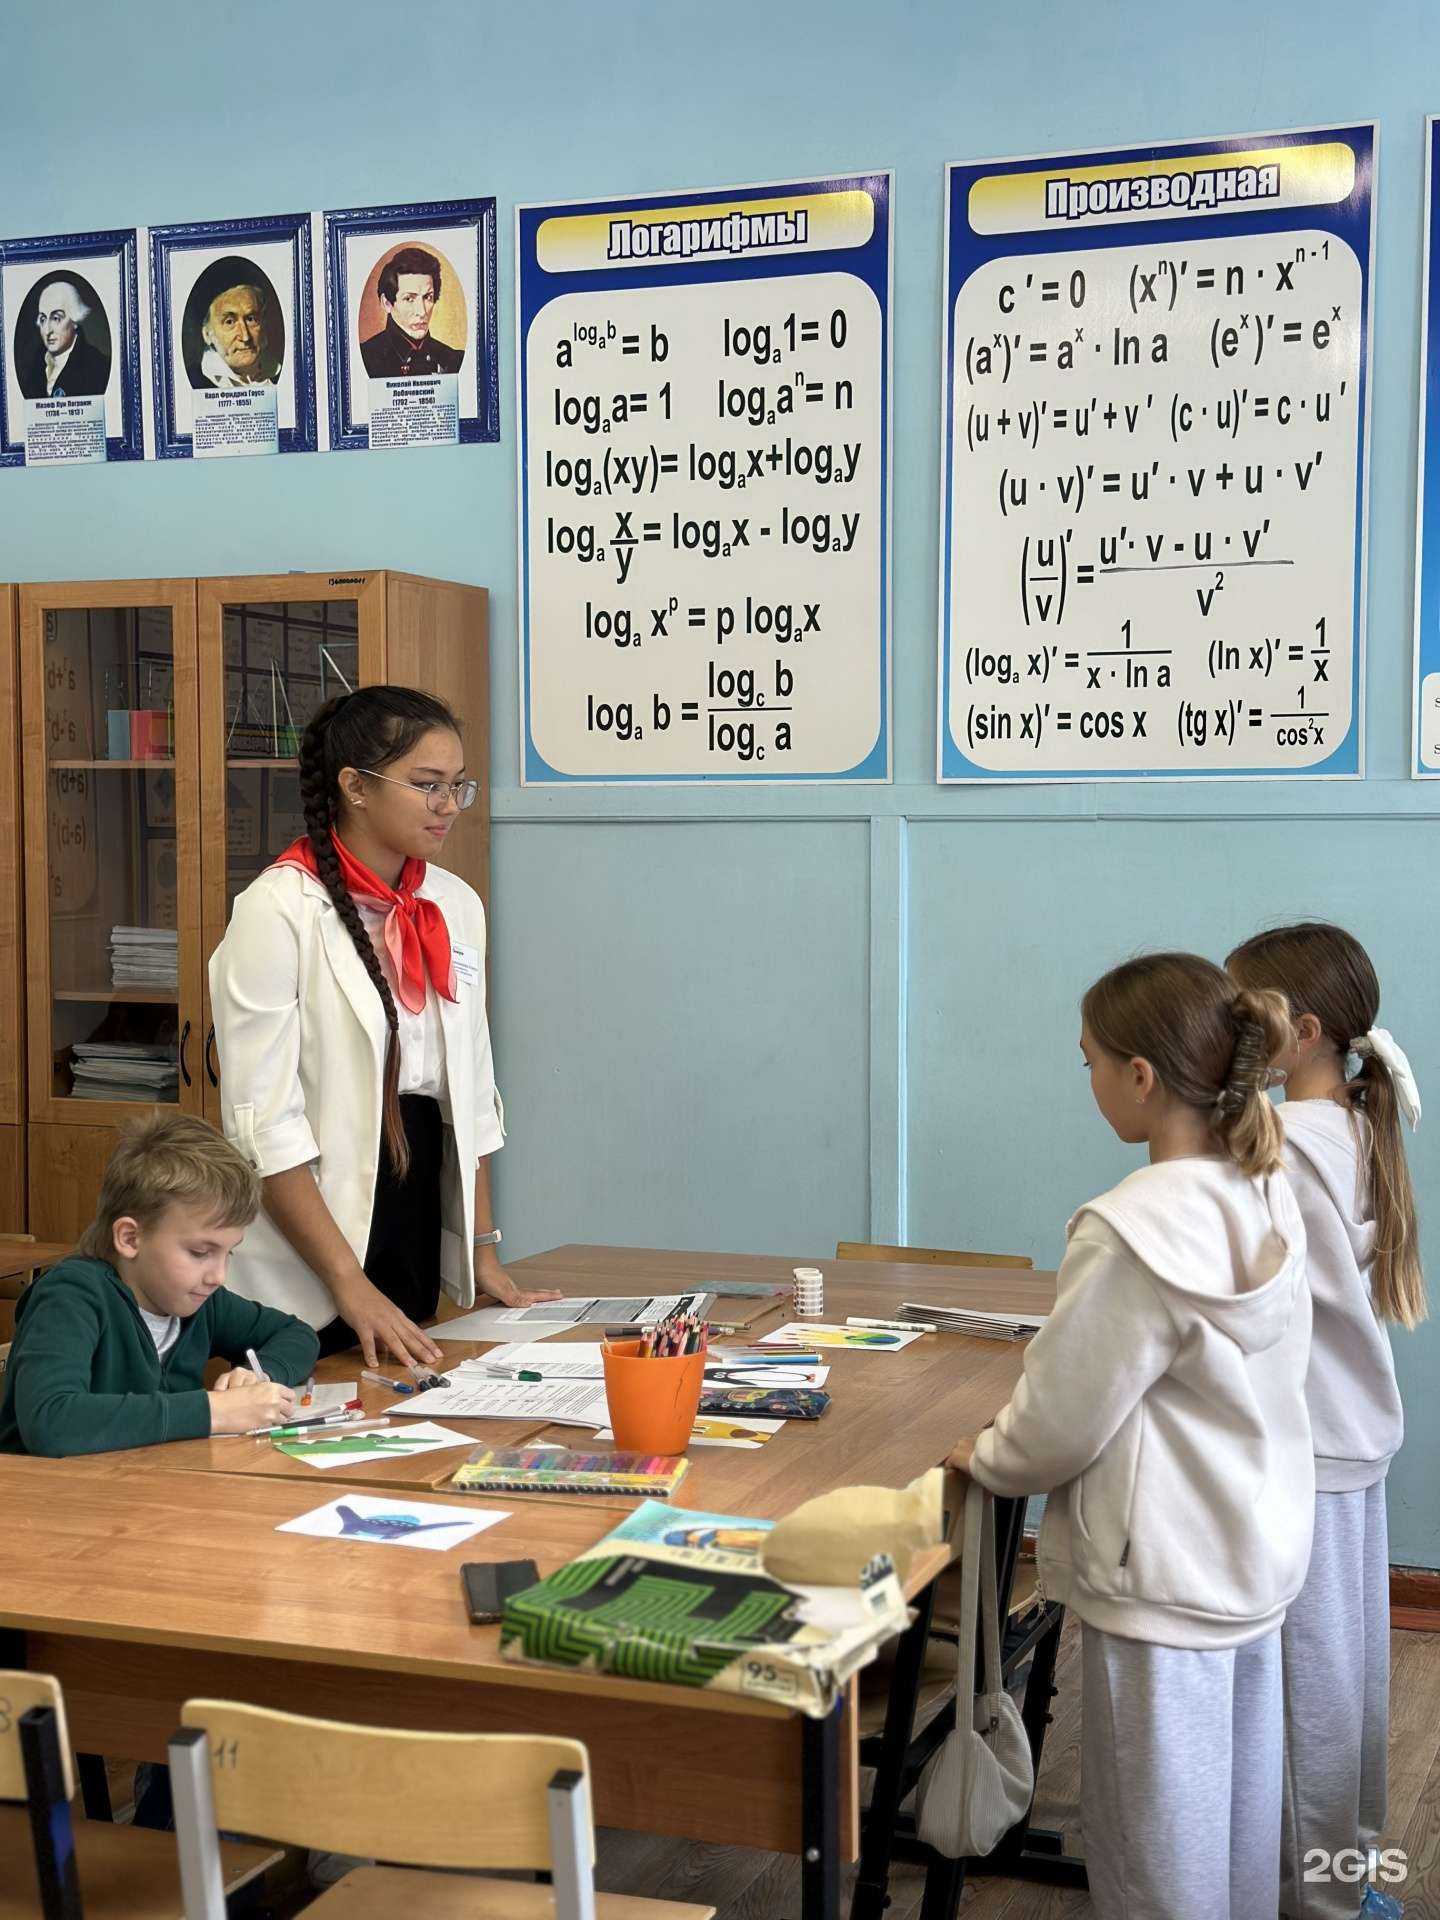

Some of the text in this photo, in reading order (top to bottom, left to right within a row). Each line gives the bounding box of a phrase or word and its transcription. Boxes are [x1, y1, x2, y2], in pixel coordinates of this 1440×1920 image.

[1045, 164, 1280, 218] Производная
[607, 210, 808, 260] Логарифмы
[747, 1660, 778, 1682] 95
